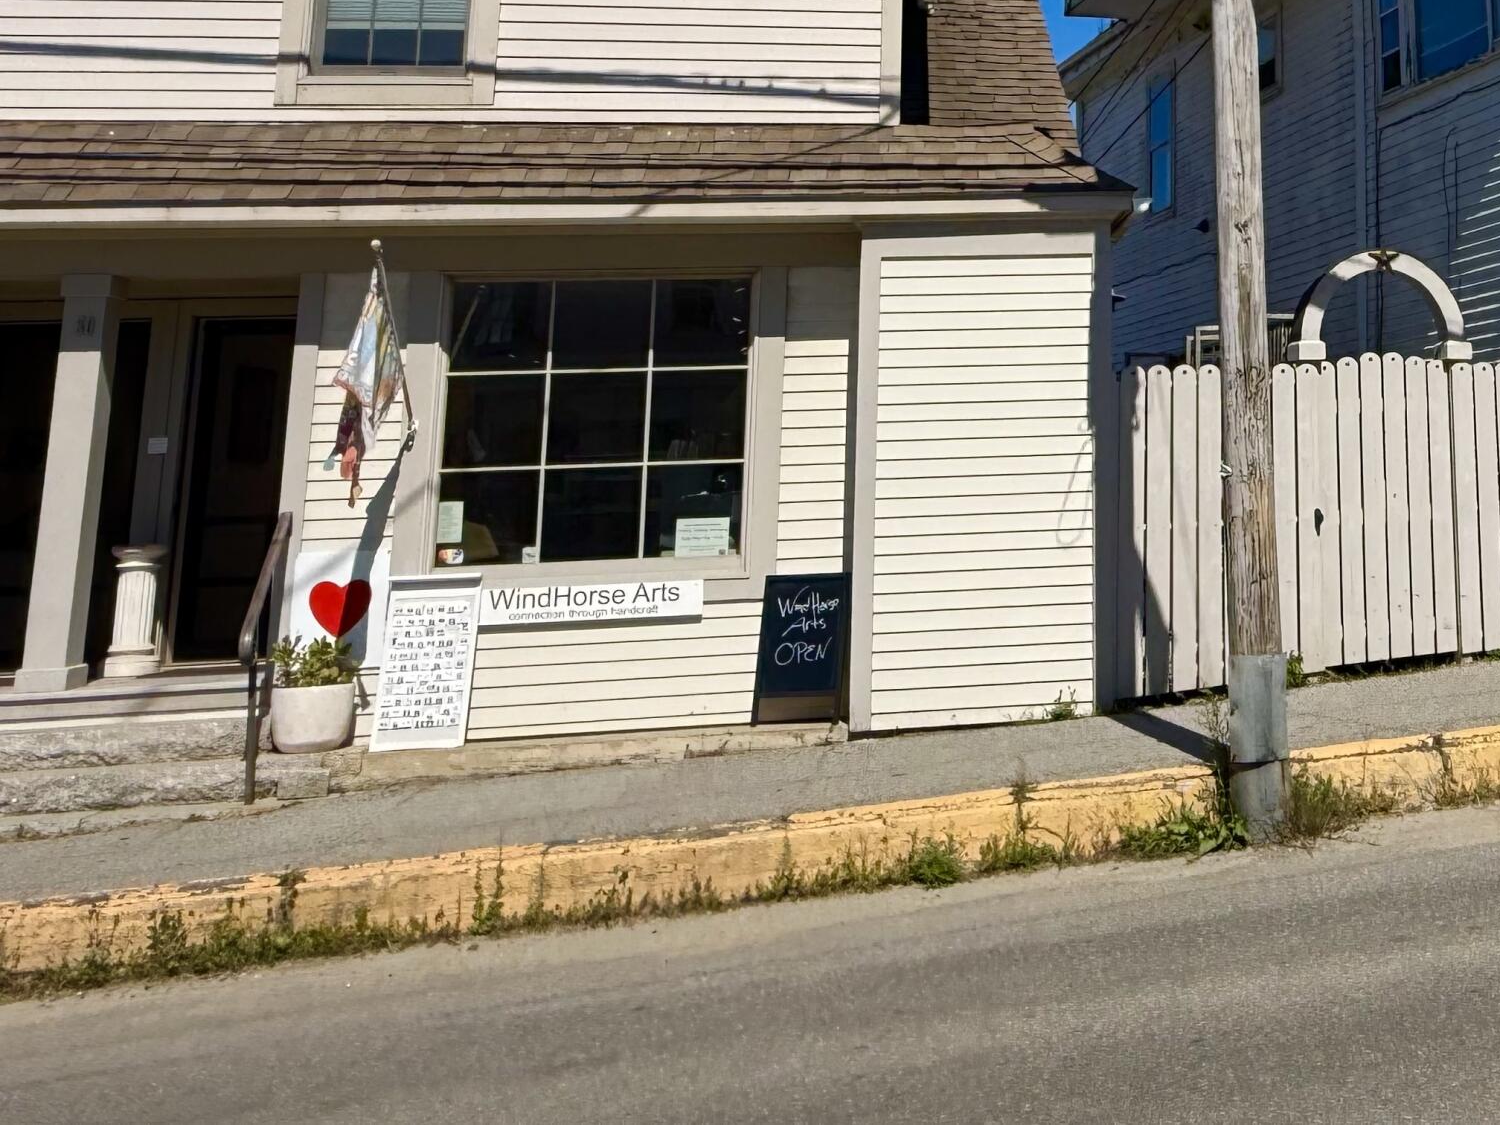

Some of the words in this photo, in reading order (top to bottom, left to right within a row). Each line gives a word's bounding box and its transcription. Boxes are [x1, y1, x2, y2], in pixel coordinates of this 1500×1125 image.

[489, 586, 626, 610] WindHorse
[632, 582, 680, 603] Arts
[781, 616, 827, 637] Arts
[774, 636, 833, 666] OPEN
